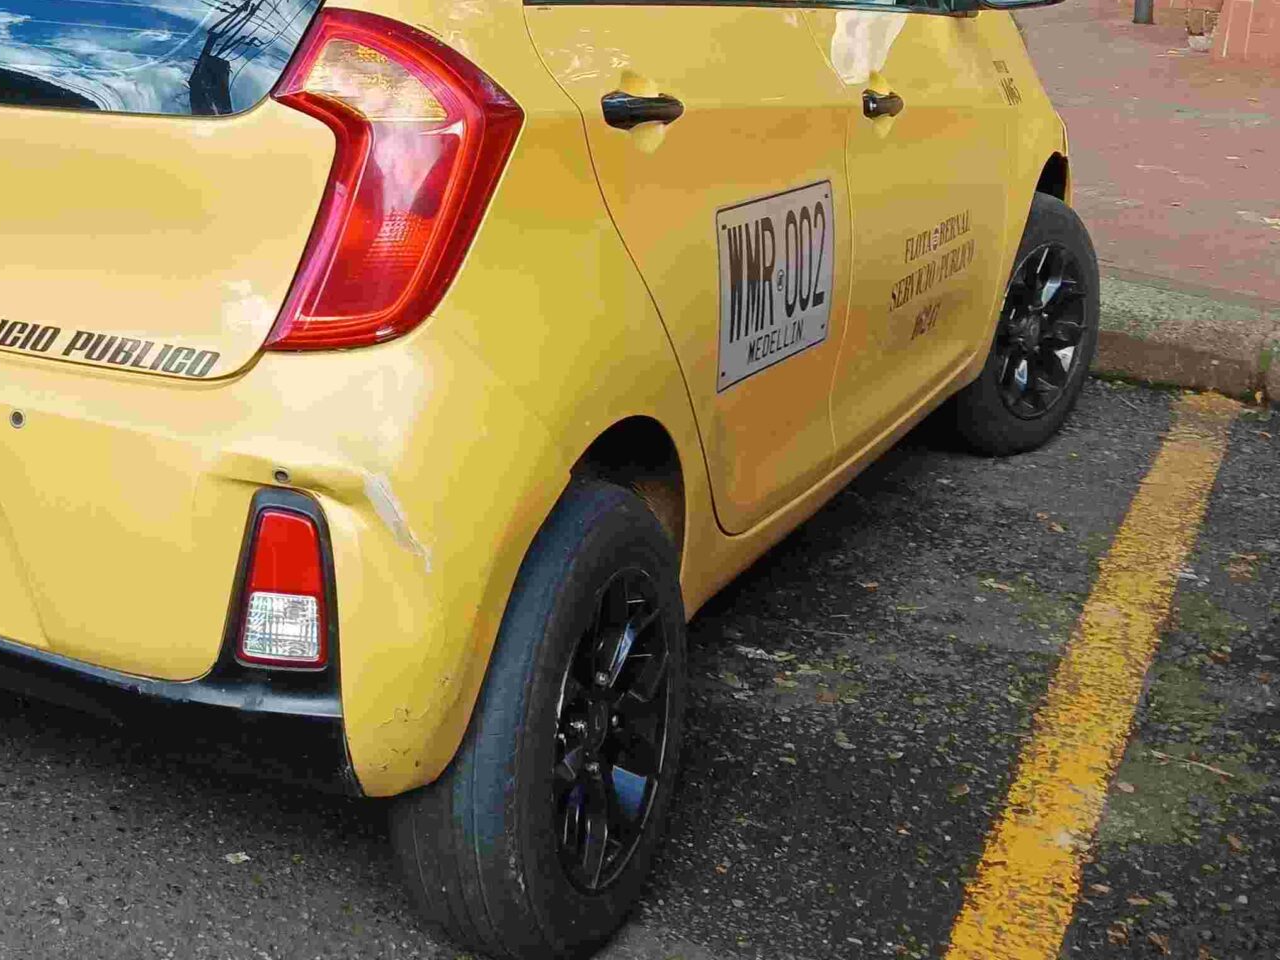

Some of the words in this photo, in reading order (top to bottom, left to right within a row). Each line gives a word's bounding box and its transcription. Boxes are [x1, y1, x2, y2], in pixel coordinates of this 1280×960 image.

[727, 215, 776, 344] WMR
[784, 200, 826, 318] 002
[62, 330, 221, 378] PUBLICO
[746, 318, 804, 365] MEDELLIN
